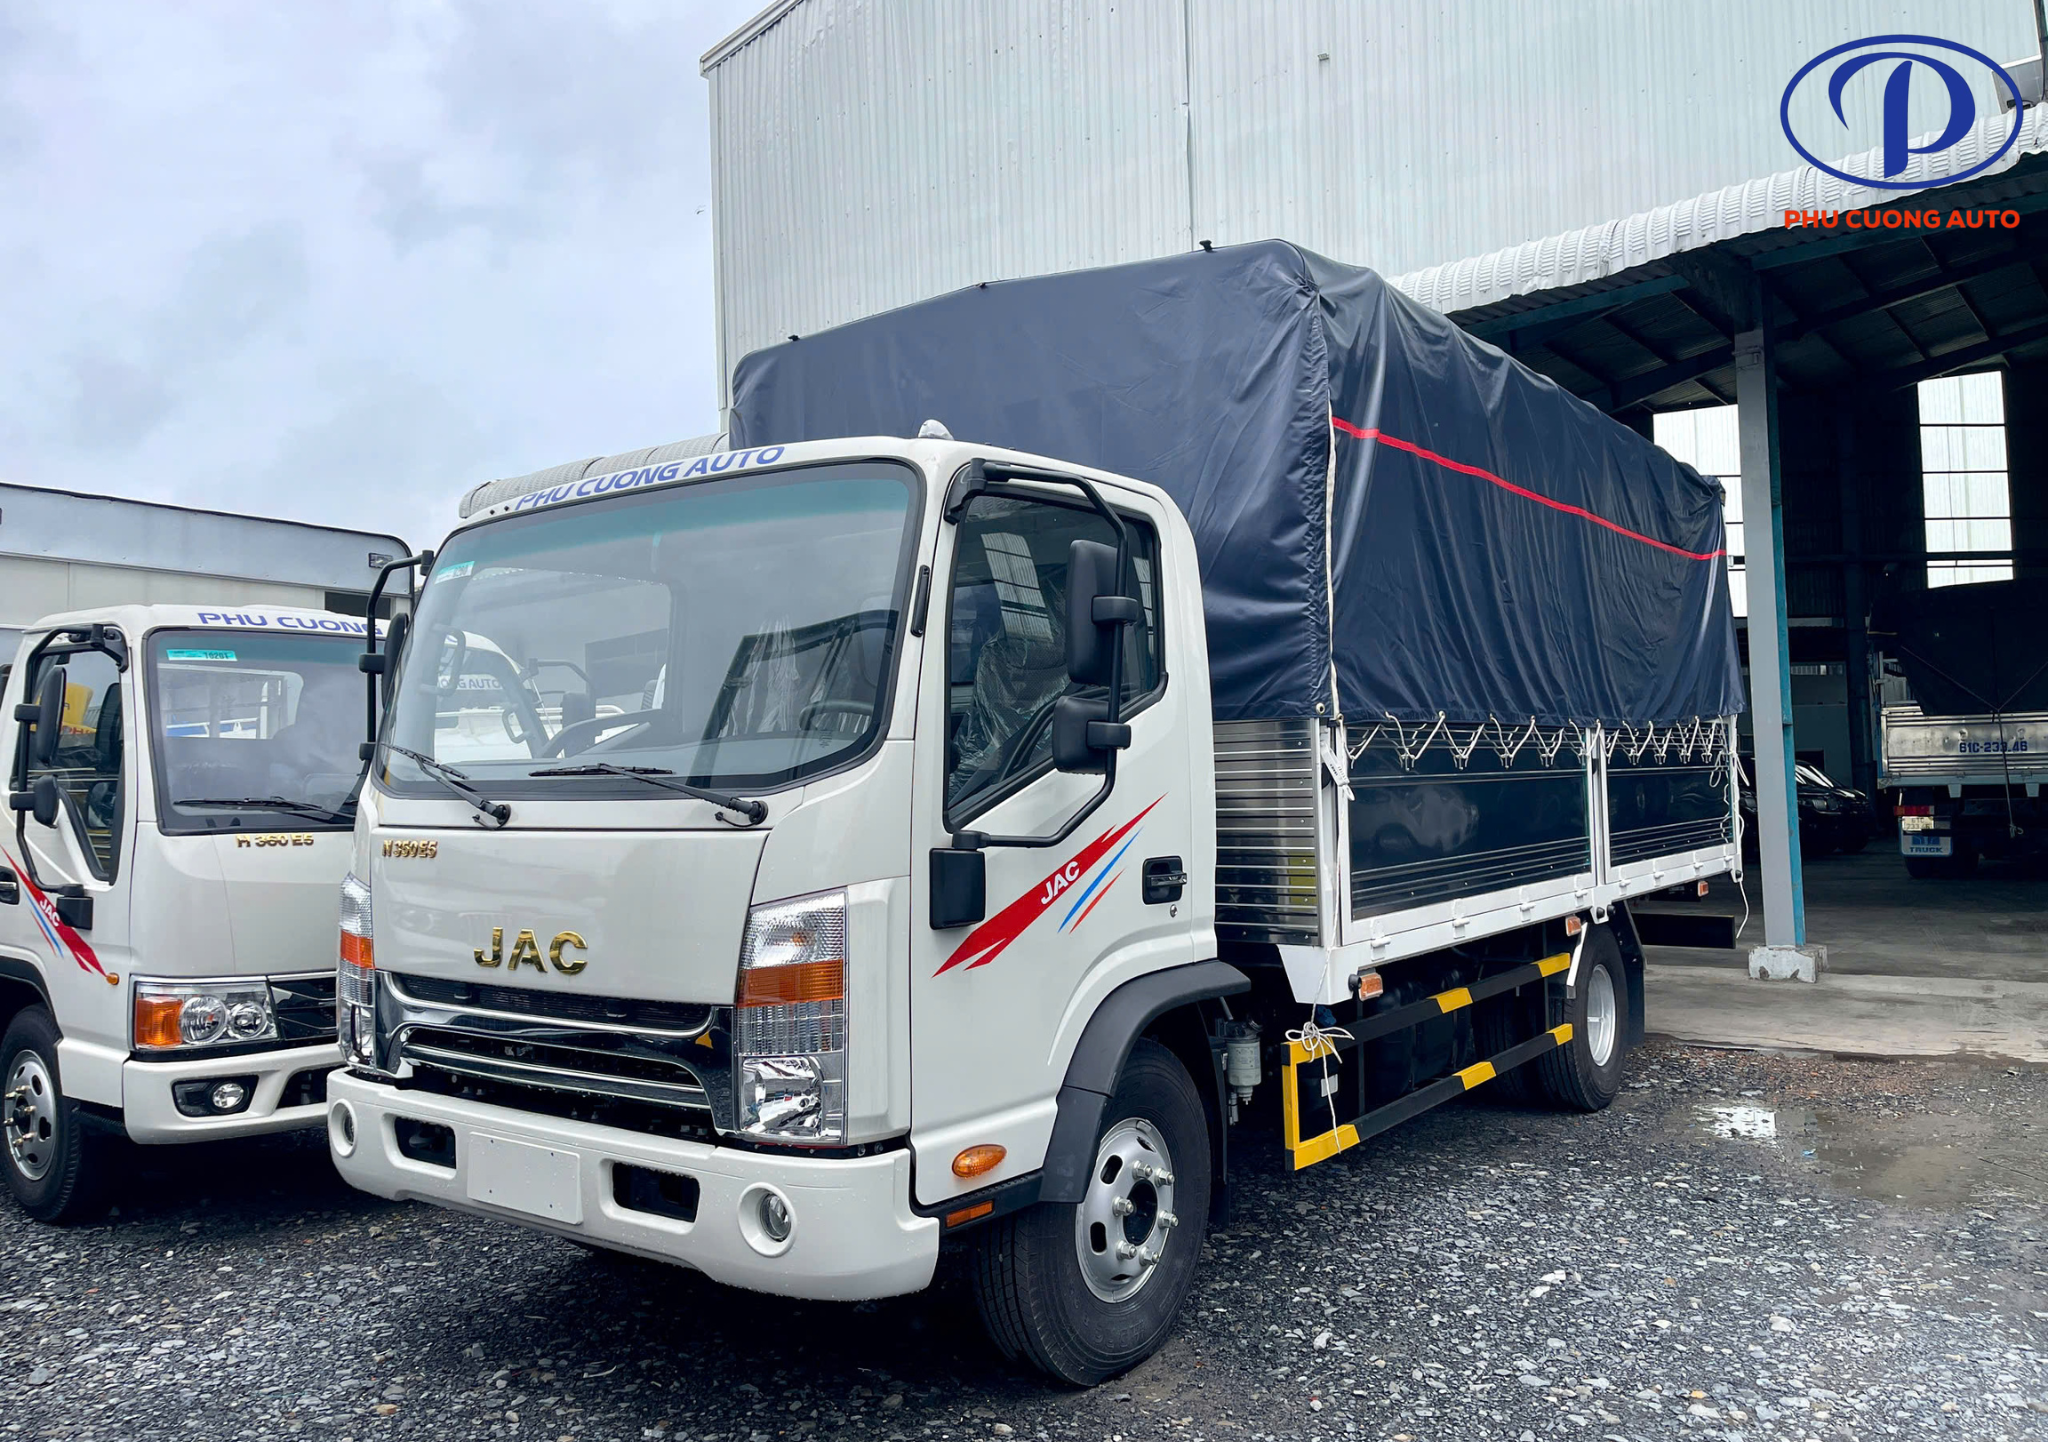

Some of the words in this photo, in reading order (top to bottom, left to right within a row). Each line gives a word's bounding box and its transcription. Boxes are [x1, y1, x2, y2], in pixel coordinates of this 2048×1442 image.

[514, 483, 573, 511] PHU
[575, 461, 684, 497] CUONG
[684, 446, 785, 478] AUTO
[197, 612, 268, 626] PHU
[1041, 861, 1080, 905] JAC
[40, 899, 61, 927] JAC
[473, 926, 588, 976] JAC
